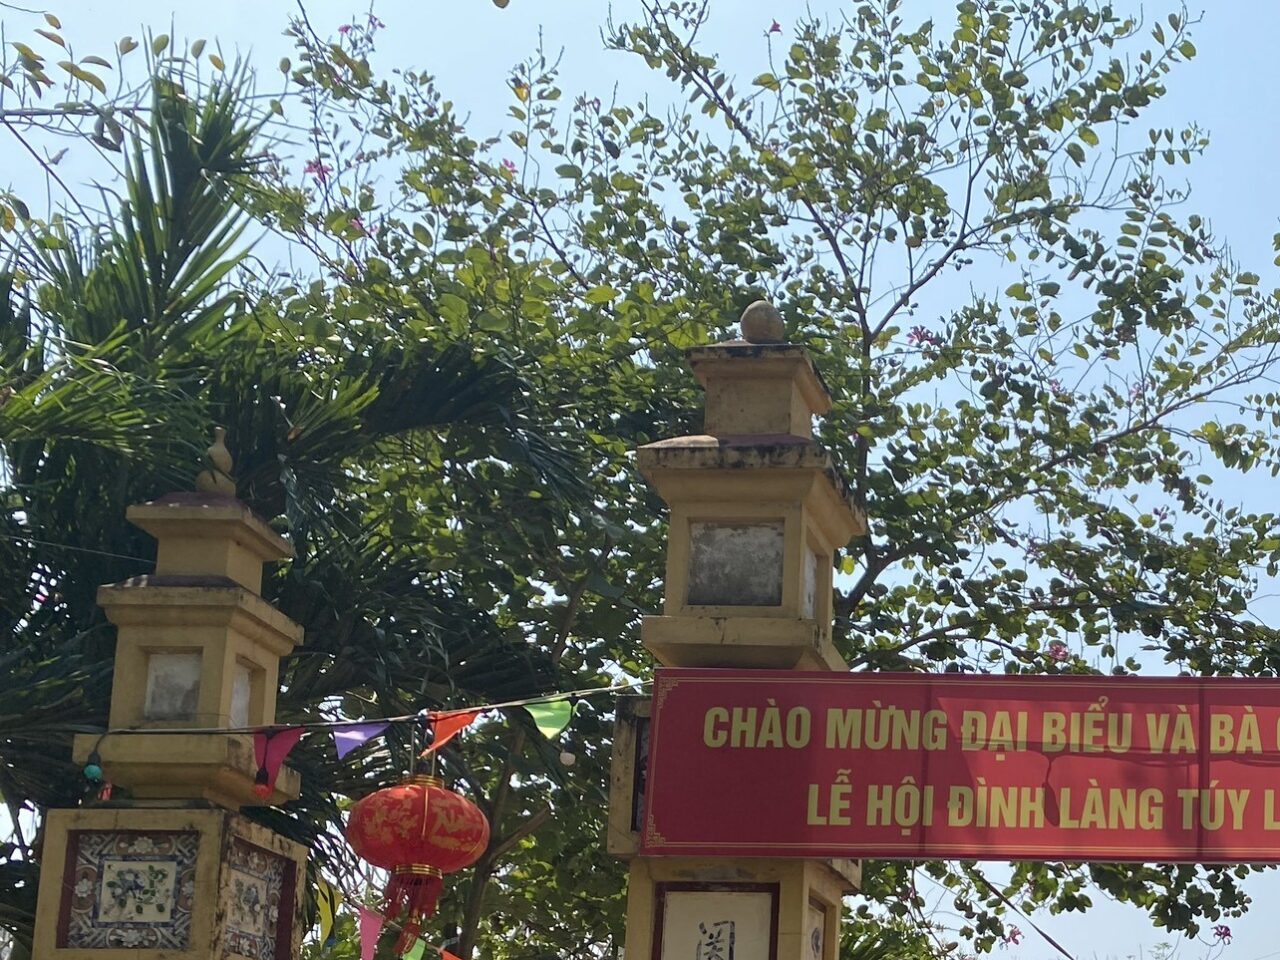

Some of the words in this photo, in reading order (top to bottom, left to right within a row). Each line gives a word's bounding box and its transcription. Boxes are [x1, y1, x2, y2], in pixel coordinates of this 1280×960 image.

[703, 698, 812, 749] CHÀO
[826, 699, 948, 751] MỪNG
[961, 710, 1029, 762] ĐẠI
[1042, 695, 1133, 754] BIỂU
[1146, 705, 1197, 754] VÀ
[1210, 704, 1263, 754] BÀ
[806, 769, 853, 827] LỄ
[866, 776, 935, 836] HỘI
[947, 777, 1047, 829] ĐÌNH
[1059, 777, 1164, 830] LÀNG
[1178, 779, 1250, 831] TÚY
